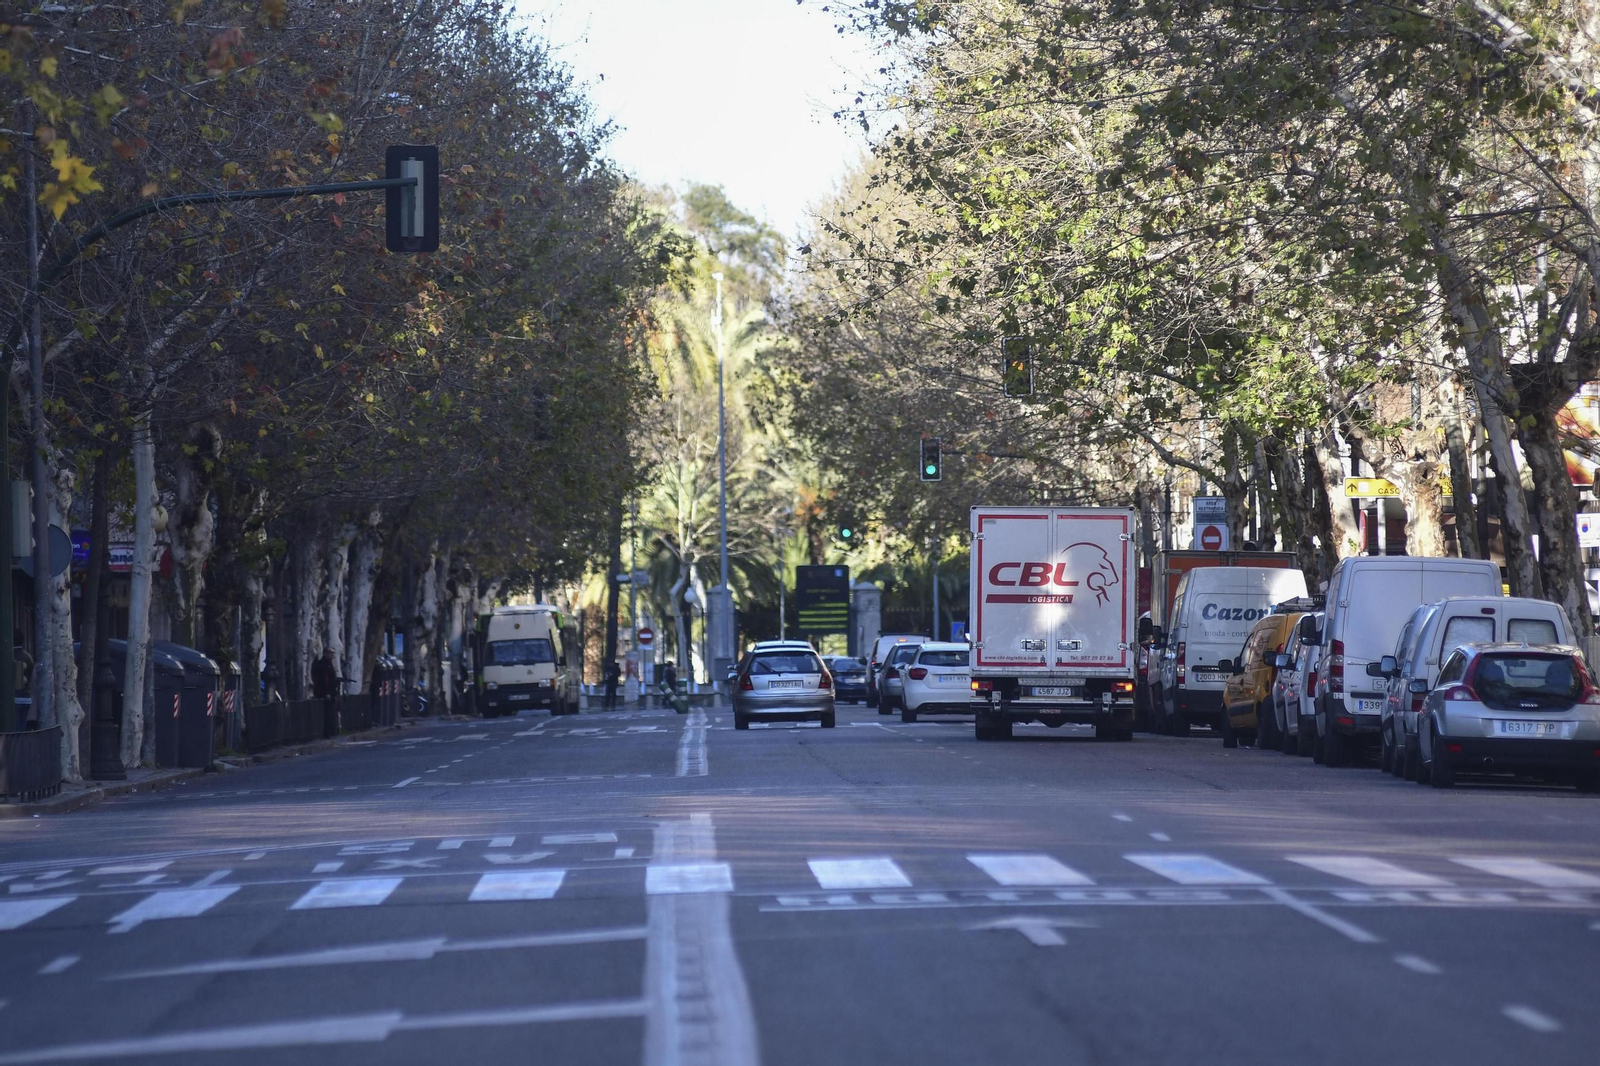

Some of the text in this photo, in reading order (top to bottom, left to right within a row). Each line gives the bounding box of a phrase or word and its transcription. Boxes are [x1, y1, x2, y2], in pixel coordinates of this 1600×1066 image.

[988, 562, 1079, 587] CBL
[1199, 673, 1216, 681] 2003
[1508, 722, 1555, 733] 6317 FYP
